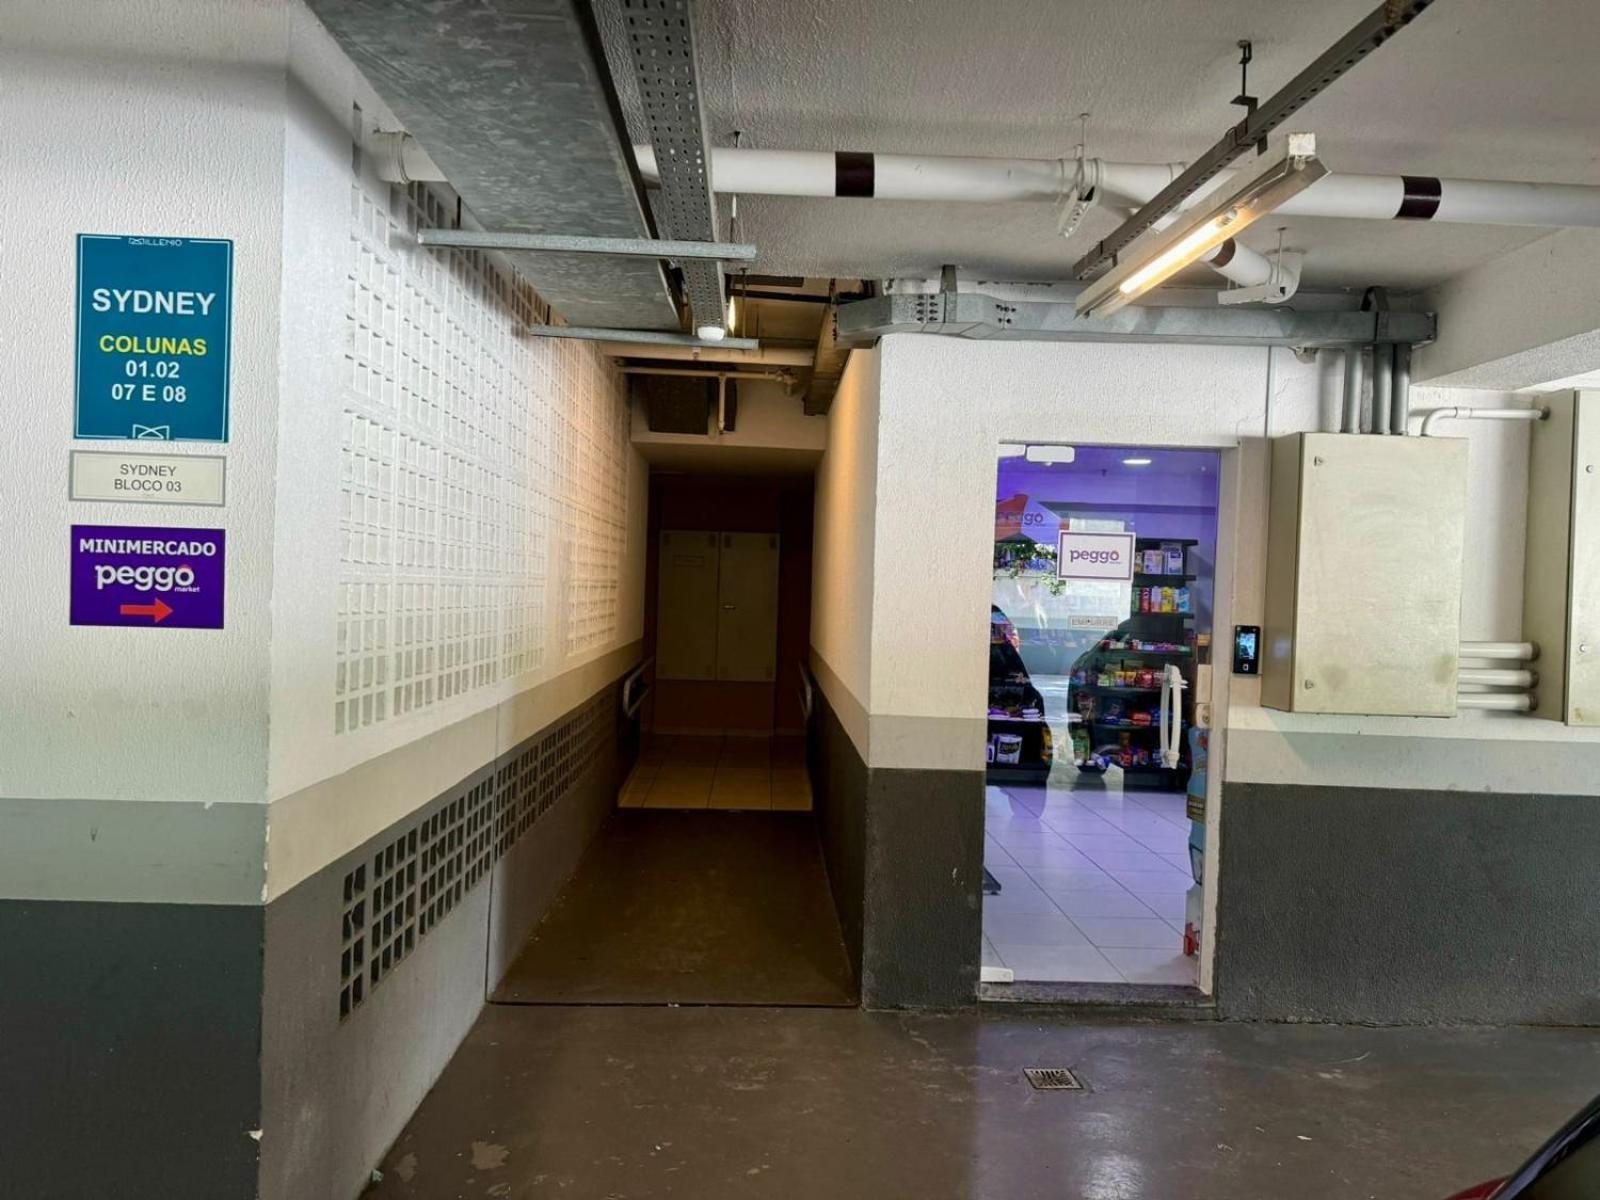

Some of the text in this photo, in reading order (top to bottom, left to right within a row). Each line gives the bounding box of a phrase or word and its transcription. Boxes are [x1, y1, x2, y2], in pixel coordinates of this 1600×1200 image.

[92, 288, 216, 315] SYDNEY
[99, 335, 207, 356] COLUNAS
[125, 360, 180, 379] 01.02
[111, 384, 186, 402] 07 E 08
[120, 464, 177, 476] SYDNEY
[114, 479, 181, 492] BLOCO 03
[79, 538, 216, 556] MINIMERCADO
[1070, 549, 1120, 563] peggo
[95, 564, 195, 591] peggo
